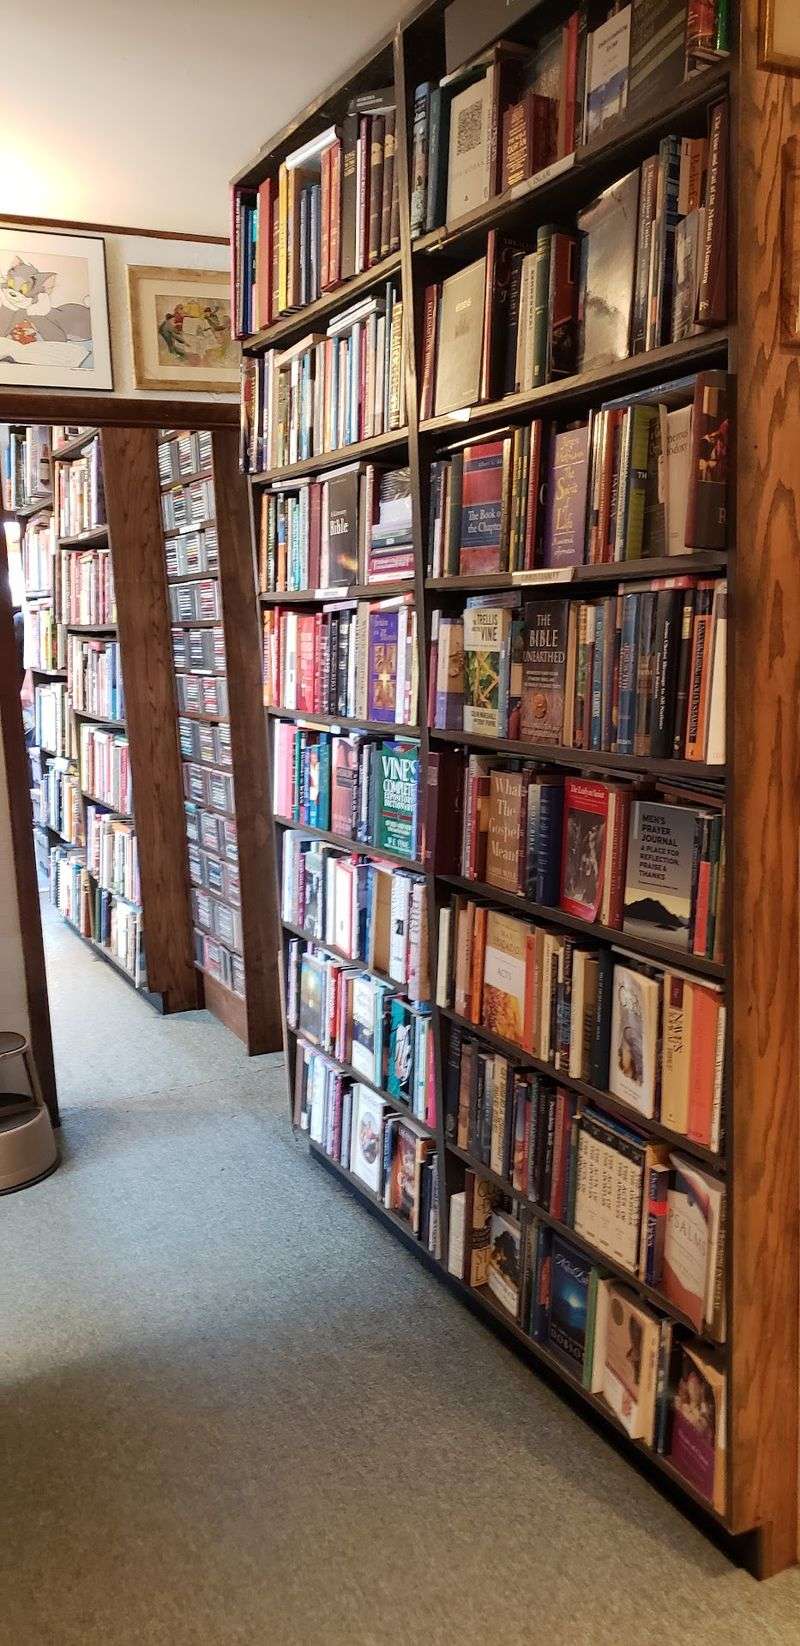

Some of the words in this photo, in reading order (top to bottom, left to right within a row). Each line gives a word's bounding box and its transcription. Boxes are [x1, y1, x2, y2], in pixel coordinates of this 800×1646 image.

[467, 510, 479, 521] The
[479, 508, 496, 520] Book
[467, 523, 478, 533] the
[478, 521, 502, 534] Chapte
[477, 613, 498, 625] TRELLIS
[536, 614, 552, 626] THE
[480, 626, 498, 642] VINE
[528, 629, 559, 647] BIBLE
[523, 650, 566, 664] UNEARTHED
[381, 755, 418, 784] VINE'S
[495, 777, 524, 797] What
[496, 798, 517, 817] The
[642, 815, 666, 825] MEN'S
[488, 817, 524, 843] Gospel
[641, 824, 673, 836] PRAYER
[641, 833, 679, 847] JOURNAL
[645, 846, 667, 855] PLACE
[667, 849, 680, 857] FOR
[639, 861, 662, 872] PRAISE
[638, 870, 666, 881] THANKS
